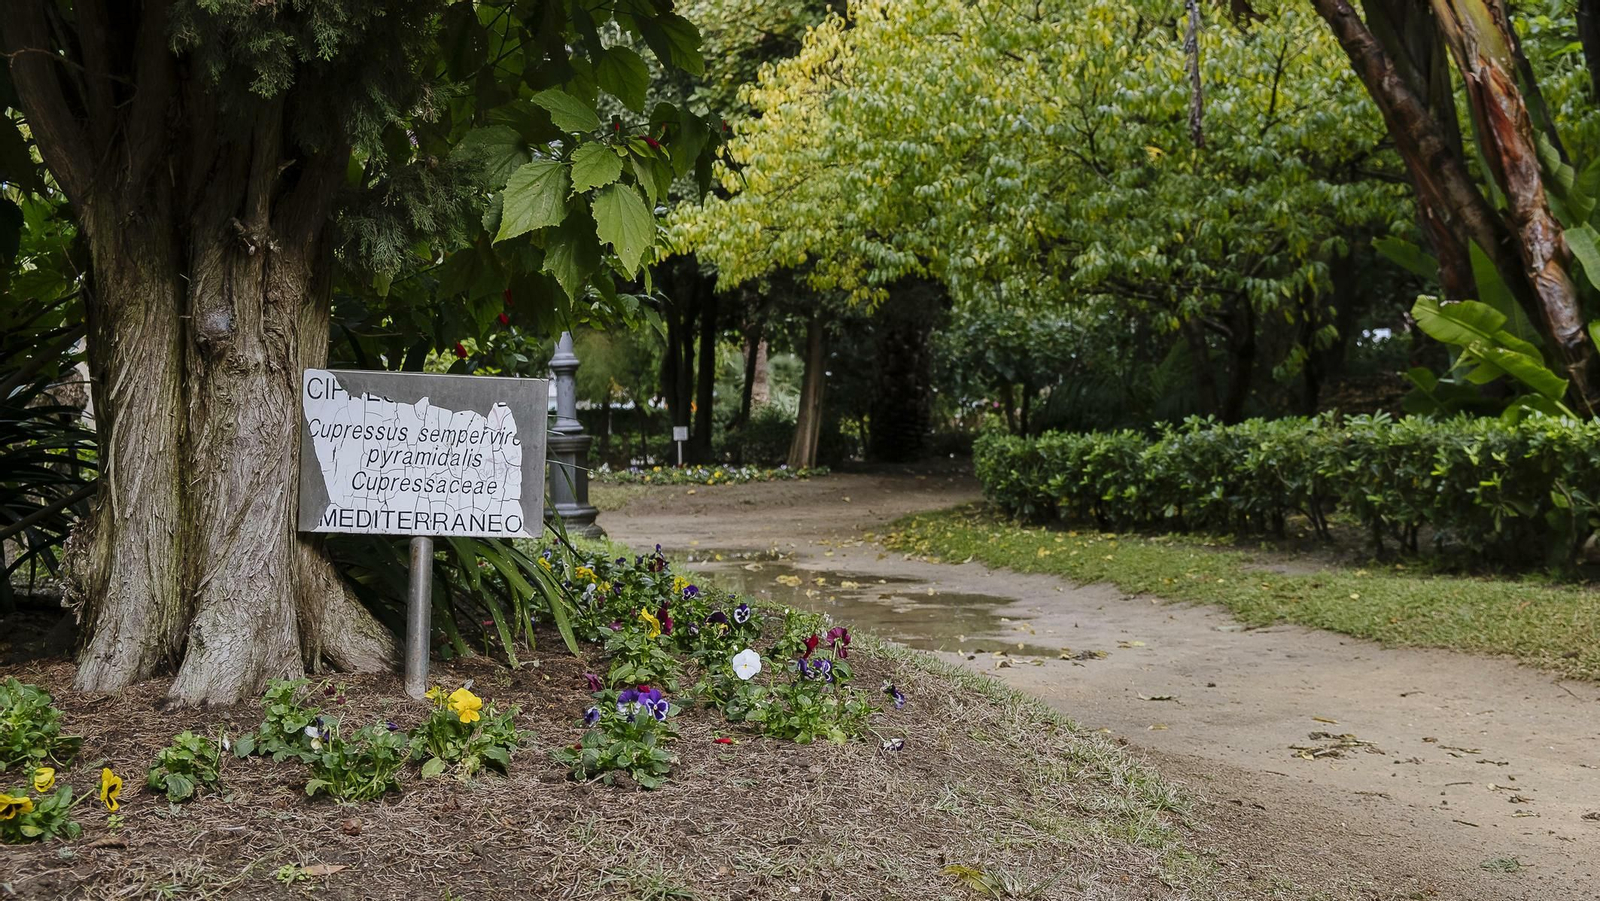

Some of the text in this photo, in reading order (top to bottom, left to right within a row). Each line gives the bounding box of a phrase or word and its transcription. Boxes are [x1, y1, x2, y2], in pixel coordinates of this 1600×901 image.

[308, 418, 409, 442] Cupressus
[366, 445, 483, 468] pyramidalis
[352, 471, 498, 495] Cupressaceae
[320, 509, 522, 533] MEDITERRANEO
